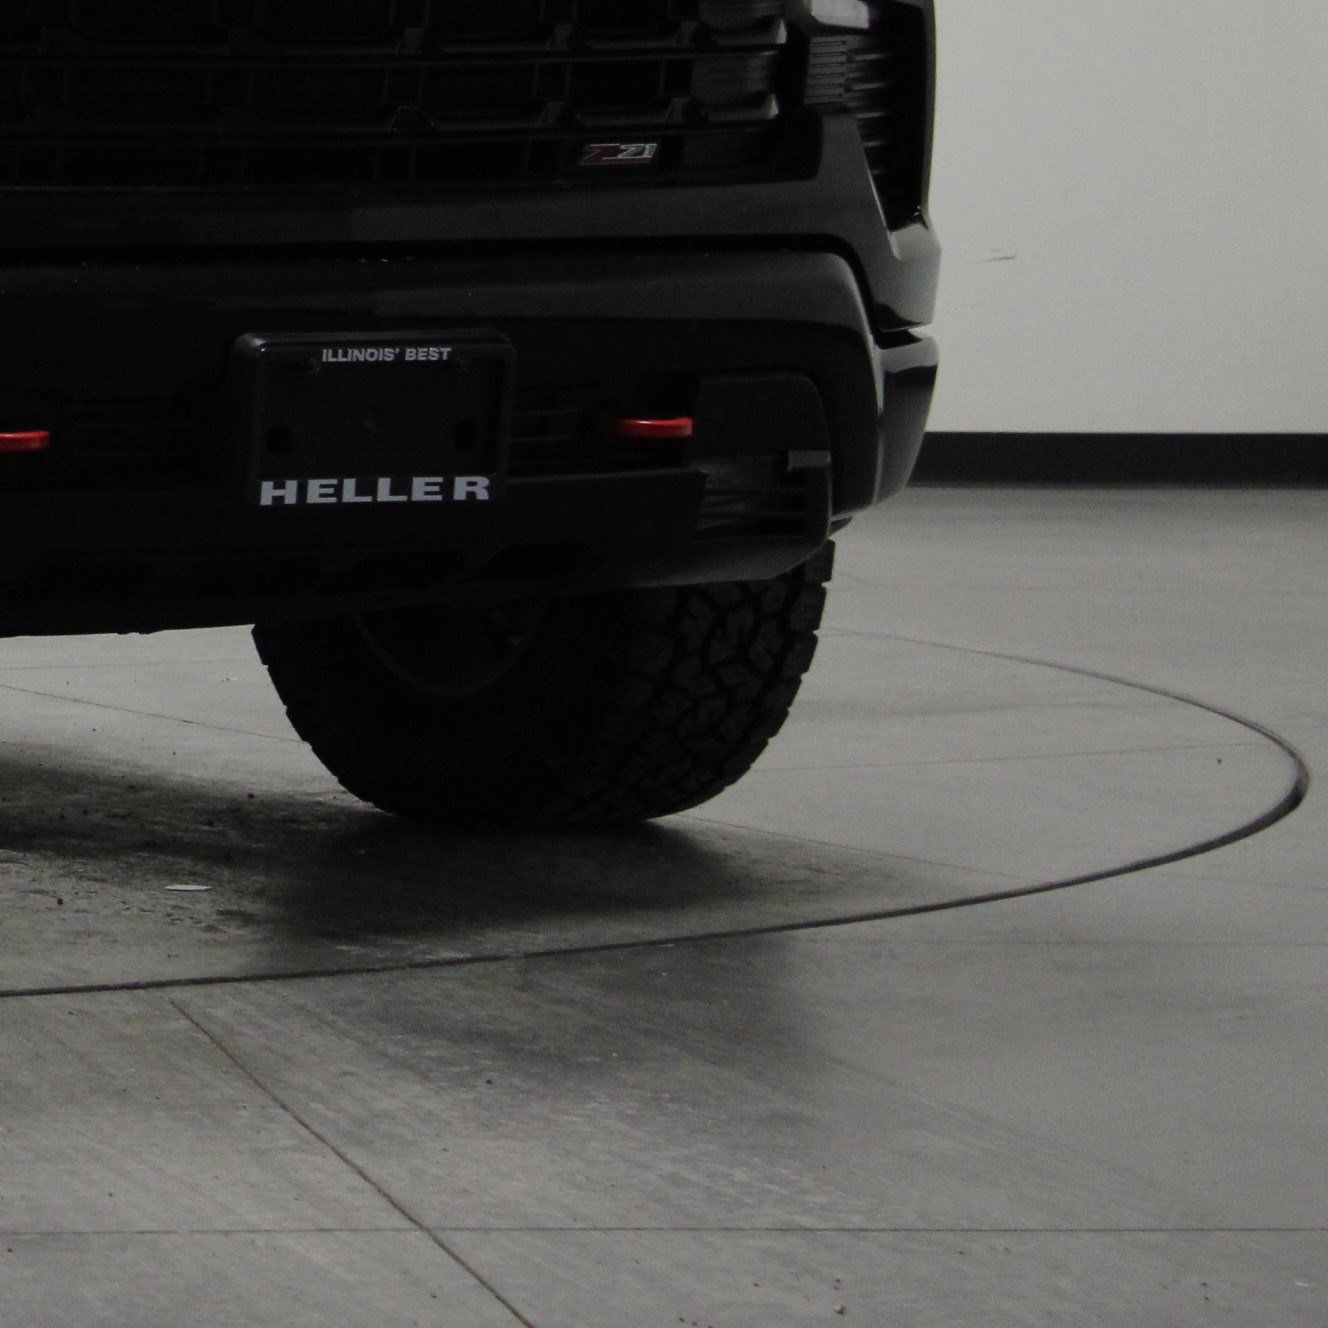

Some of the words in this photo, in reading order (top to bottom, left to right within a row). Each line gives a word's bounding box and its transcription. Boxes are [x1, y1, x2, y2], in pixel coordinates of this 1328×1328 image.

[579, 142, 659, 166] Z71
[404, 346, 453, 362] BEST
[259, 475, 491, 506] HELLER
